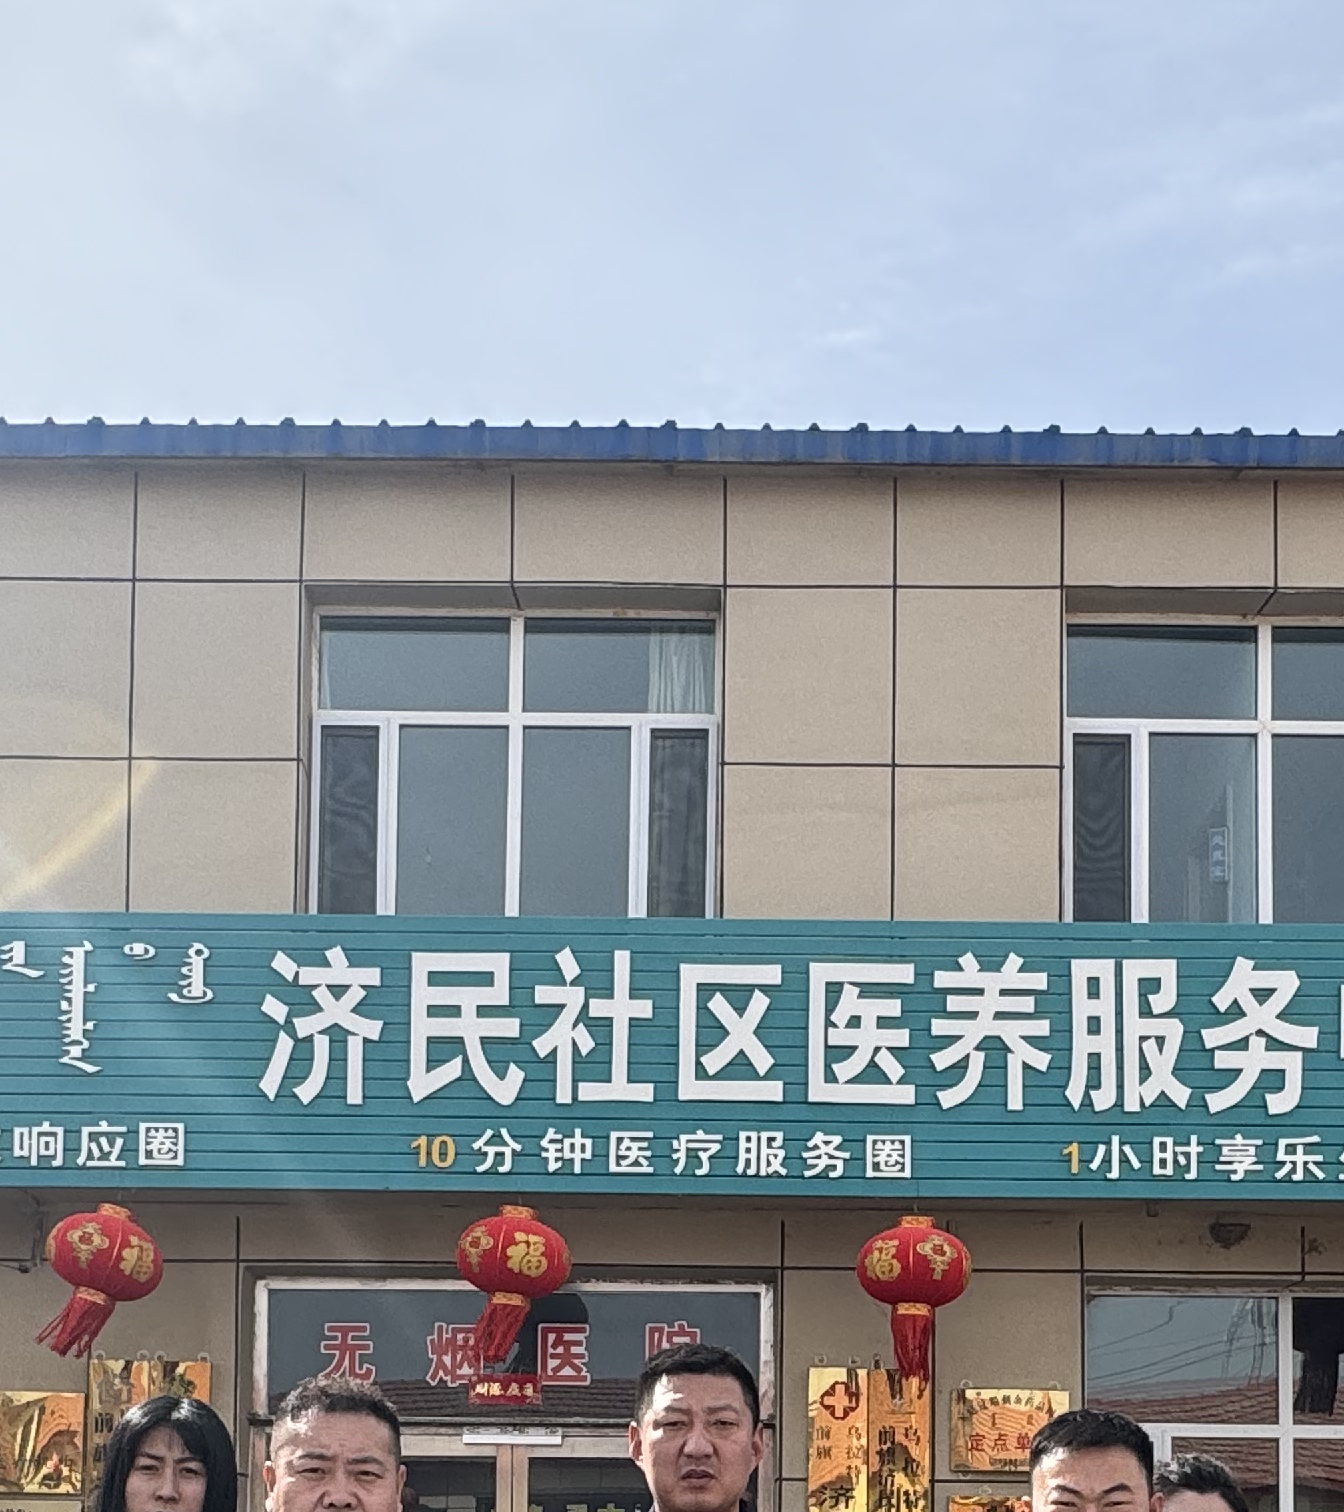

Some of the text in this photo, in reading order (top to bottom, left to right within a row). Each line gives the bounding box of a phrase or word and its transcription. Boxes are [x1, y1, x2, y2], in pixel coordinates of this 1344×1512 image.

[410, 1129, 912, 1179] 10分钟医疗服务圈
[506, 1231, 548, 1279] 福
[864, 1239, 902, 1284] 福
